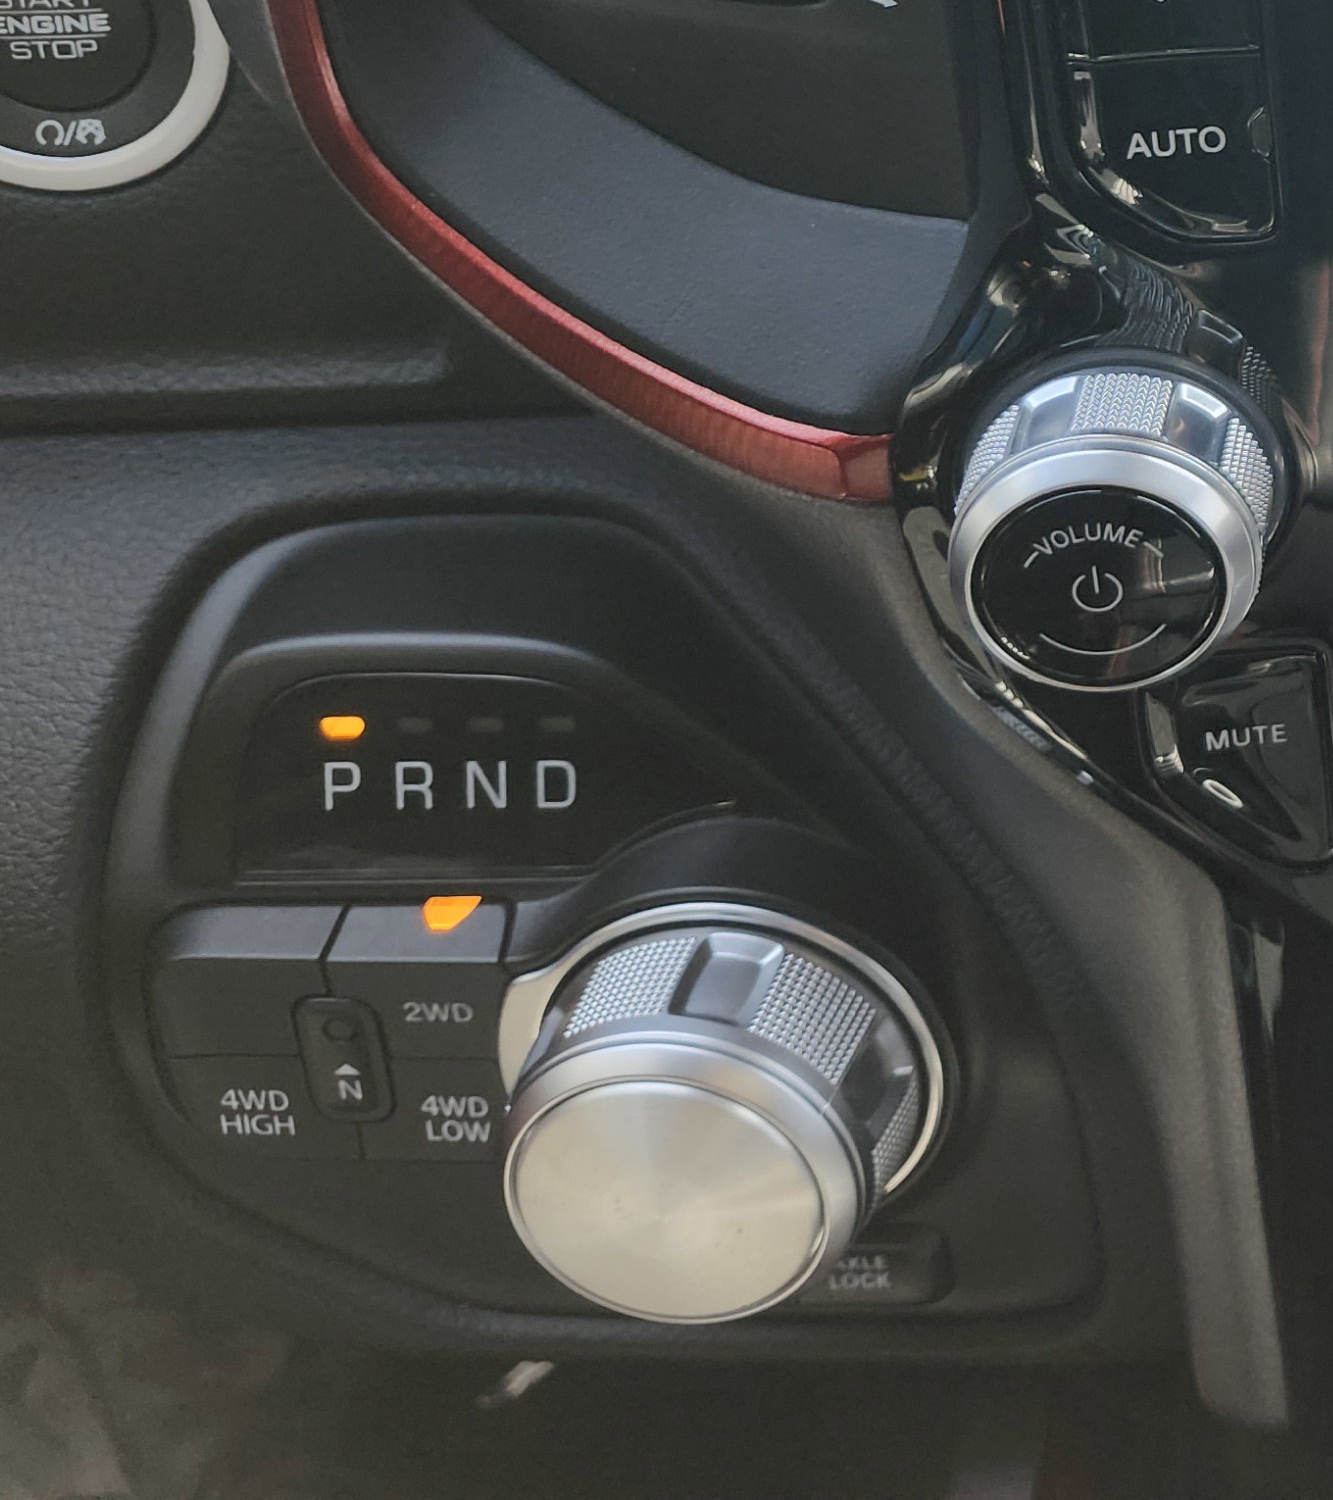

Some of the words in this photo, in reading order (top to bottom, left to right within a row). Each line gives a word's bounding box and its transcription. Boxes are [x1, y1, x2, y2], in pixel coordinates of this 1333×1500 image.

[10, 40, 98, 59] STOP
[1126, 125, 1227, 160] AUTO
[1033, 523, 1144, 556] VOLUME
[1205, 723, 1288, 752] MUTE
[323, 761, 361, 811] P
[395, 761, 434, 808] R
[466, 760, 508, 808] N
[536, 760, 577, 808] D
[403, 1000, 474, 1024] 2WD
[220, 1088, 290, 1114] 4WD
[338, 1077, 363, 1101] N
[421, 1095, 490, 1119] 4WD
[220, 1112, 296, 1138] HIGH
[426, 1119, 491, 1144] LOW
[829, 1270, 893, 1290] LOCK
